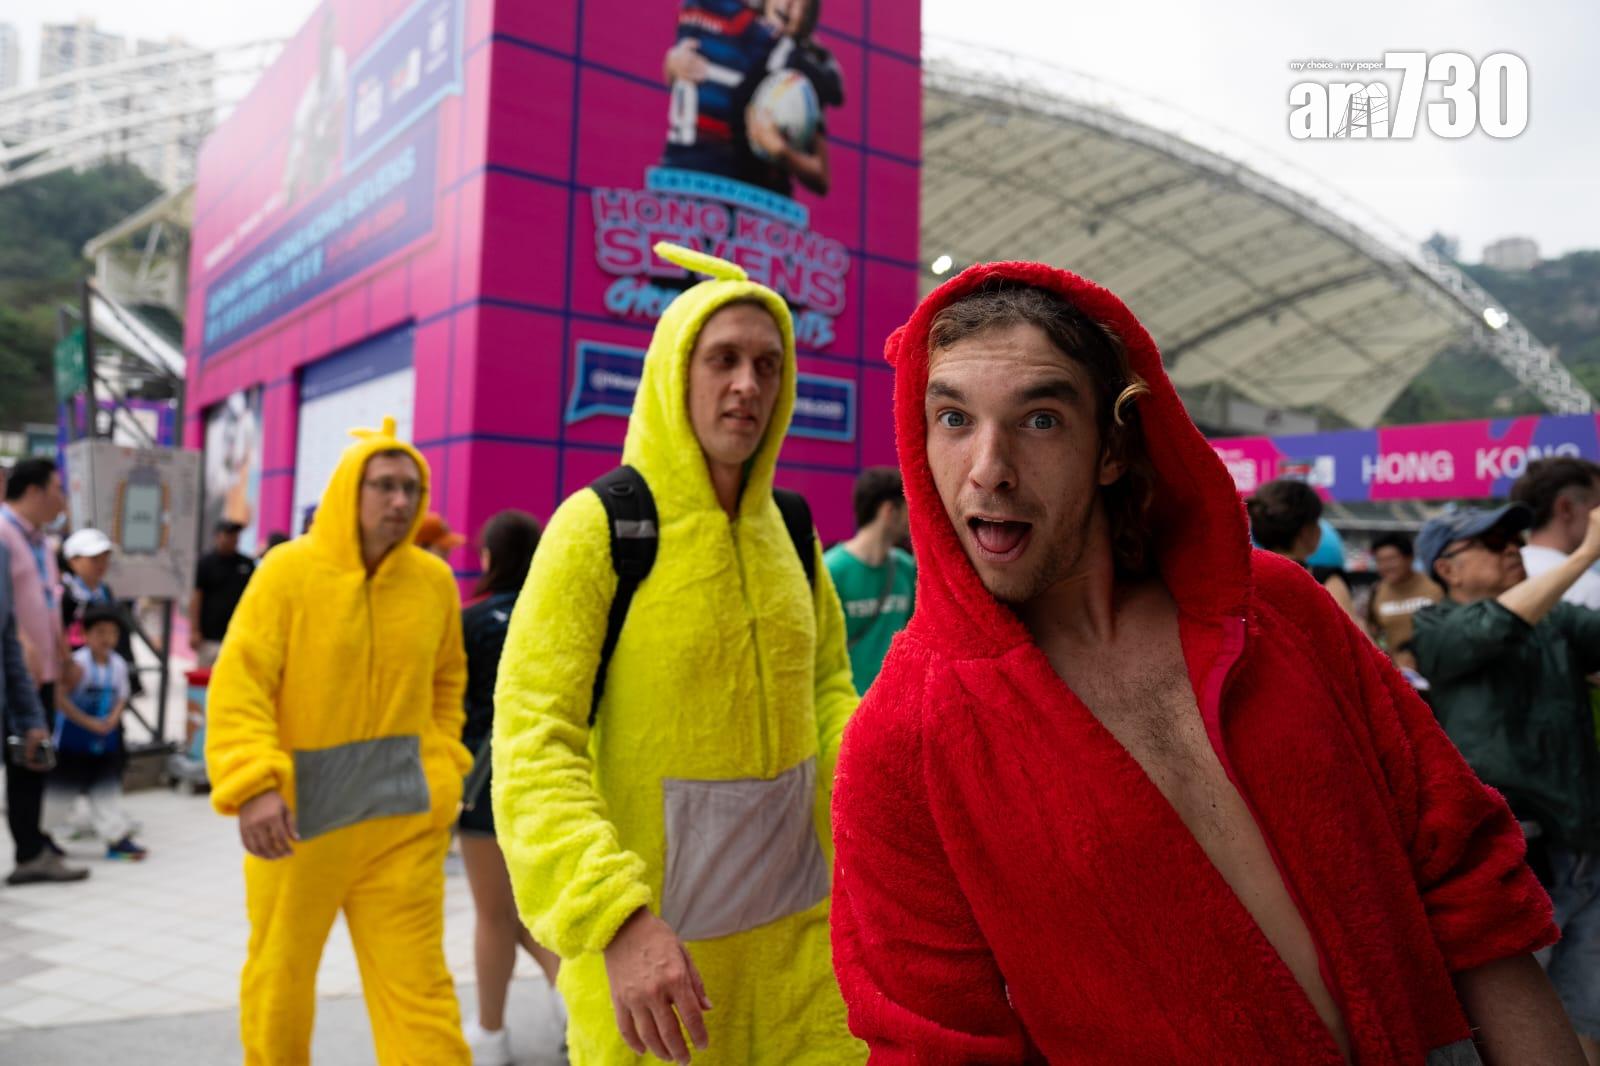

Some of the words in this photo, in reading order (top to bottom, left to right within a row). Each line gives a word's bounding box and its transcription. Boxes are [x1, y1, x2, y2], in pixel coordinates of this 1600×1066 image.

[596, 191, 729, 237] HONG
[736, 212, 850, 270] KONG
[1361, 449, 1454, 484] HONG
